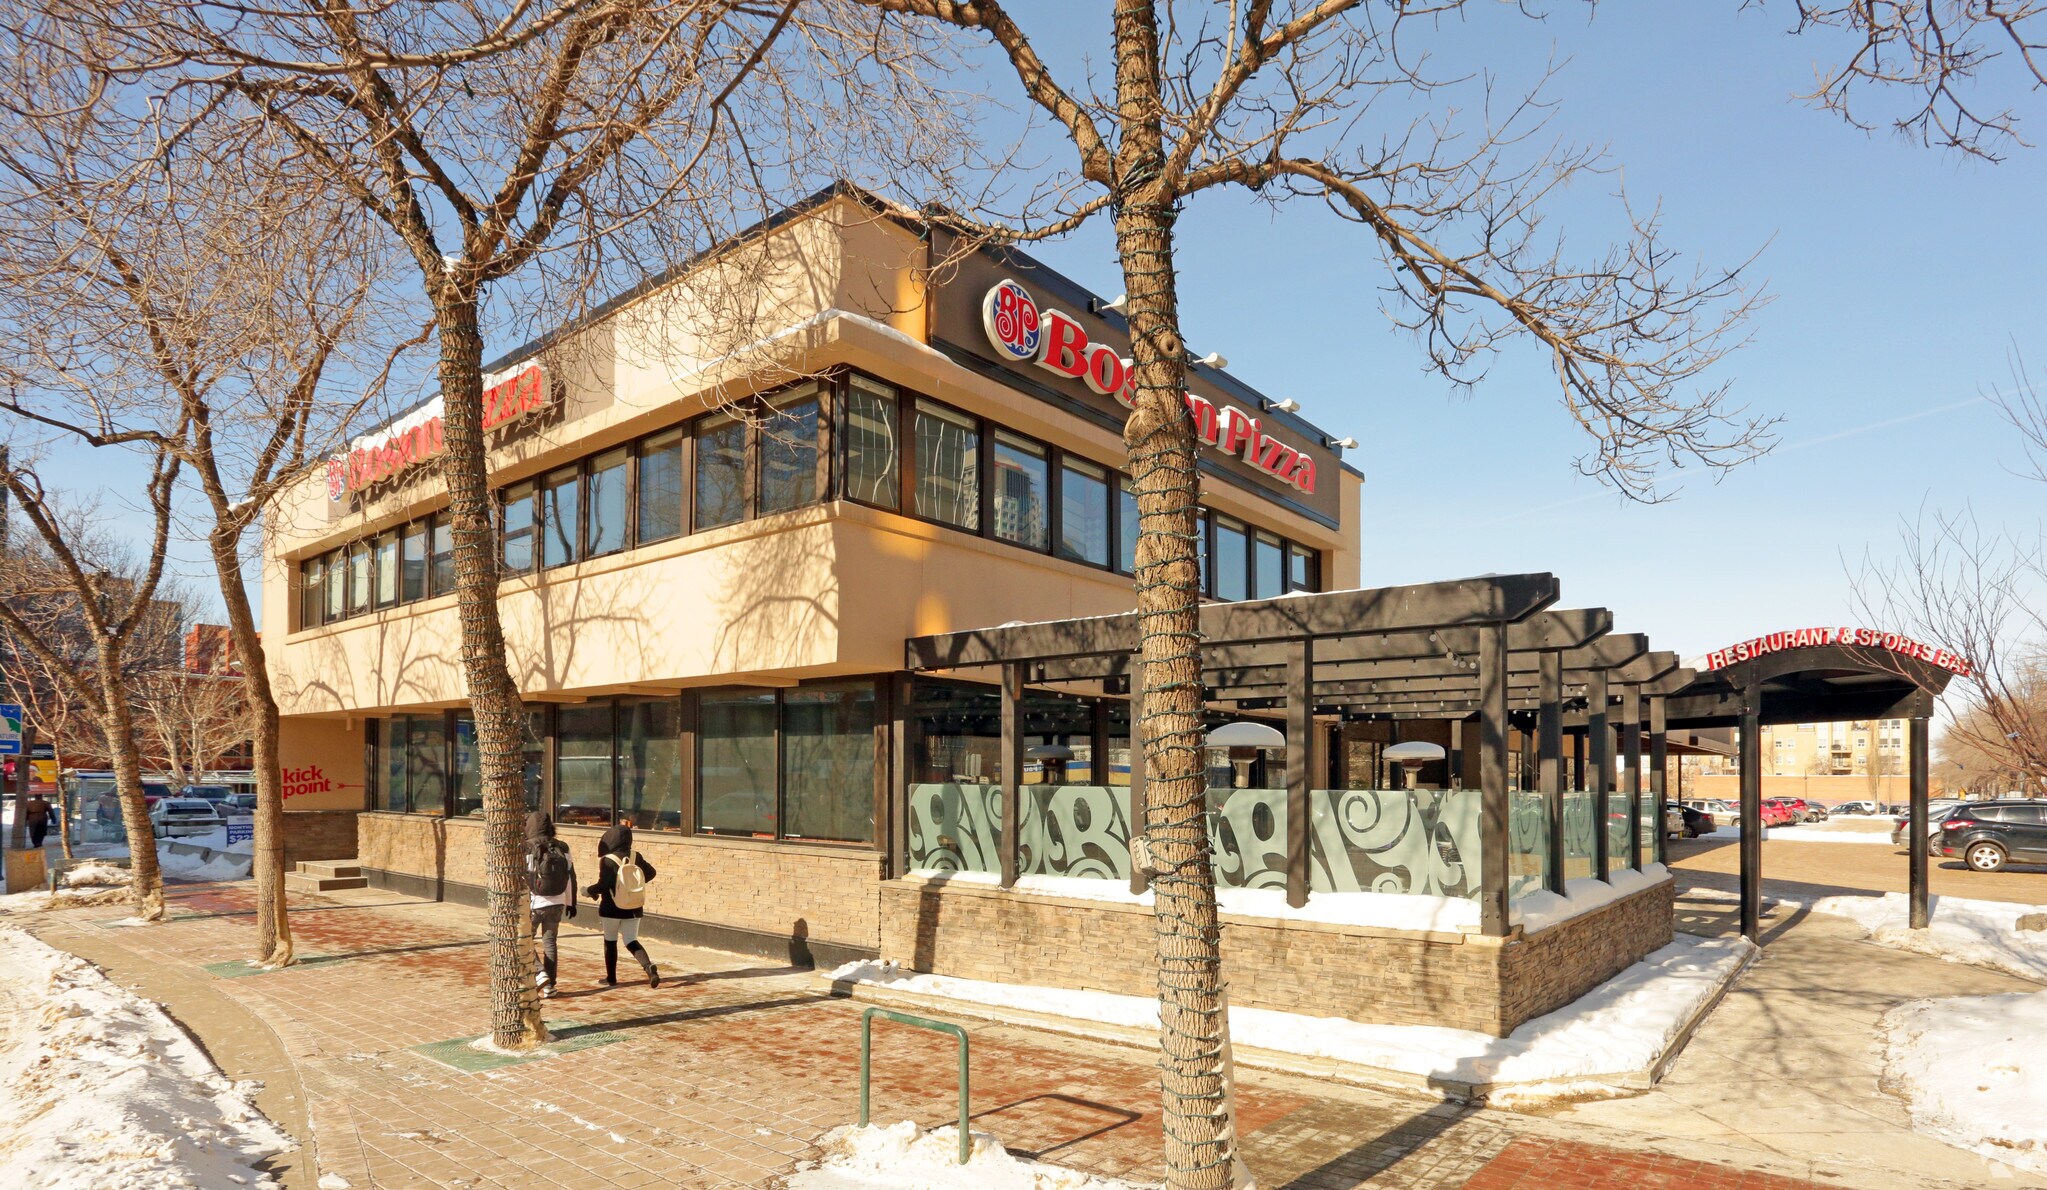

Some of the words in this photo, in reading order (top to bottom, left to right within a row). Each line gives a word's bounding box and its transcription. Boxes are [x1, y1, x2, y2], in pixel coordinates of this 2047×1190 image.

[1044, 311, 1217, 443] Bon
[1224, 409, 1317, 494] Pizza
[1707, 627, 1834, 671] RESTAURANT
[1838, 627, 1855, 645] &
[1856, 628, 1933, 661] SPORTS
[282, 764, 323, 784] kick
[282, 778, 331, 800] point
